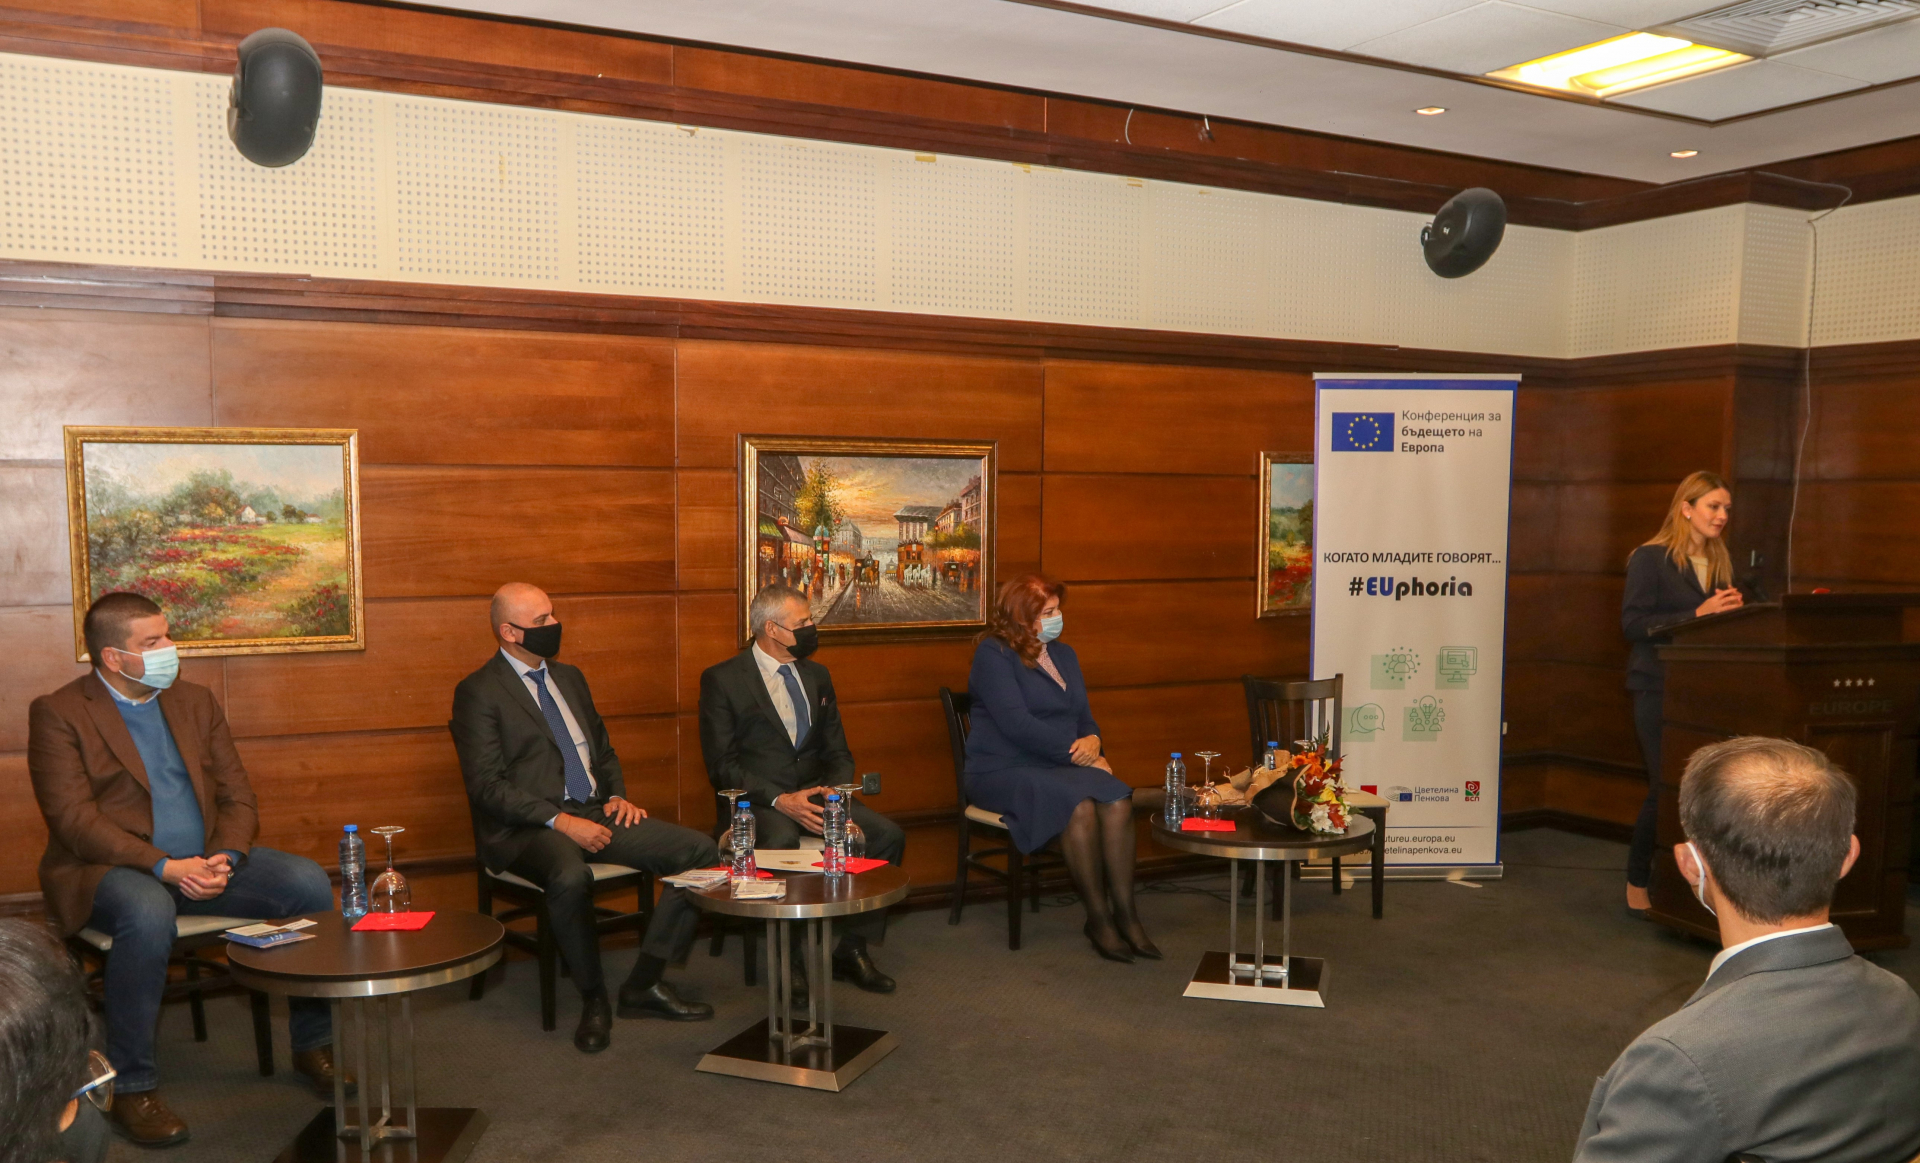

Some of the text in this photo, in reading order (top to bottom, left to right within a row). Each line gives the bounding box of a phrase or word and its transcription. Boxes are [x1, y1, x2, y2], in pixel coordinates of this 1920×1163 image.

[1401, 409, 1502, 424] Конференция за
[1401, 426, 1483, 438] бъдещето на
[1401, 442, 1445, 454] Европа
[1323, 552, 1370, 563] КОГАТО
[1372, 552, 1434, 565] МЛАДИТЕ
[1348, 576, 1473, 601] #EUphoria
[1808, 699, 1895, 715] EUROPE
[1414, 786, 1459, 795] Цветелина
[1414, 794, 1450, 802] Пенкова
[1384, 834, 1456, 845] utureu.europa.eu
